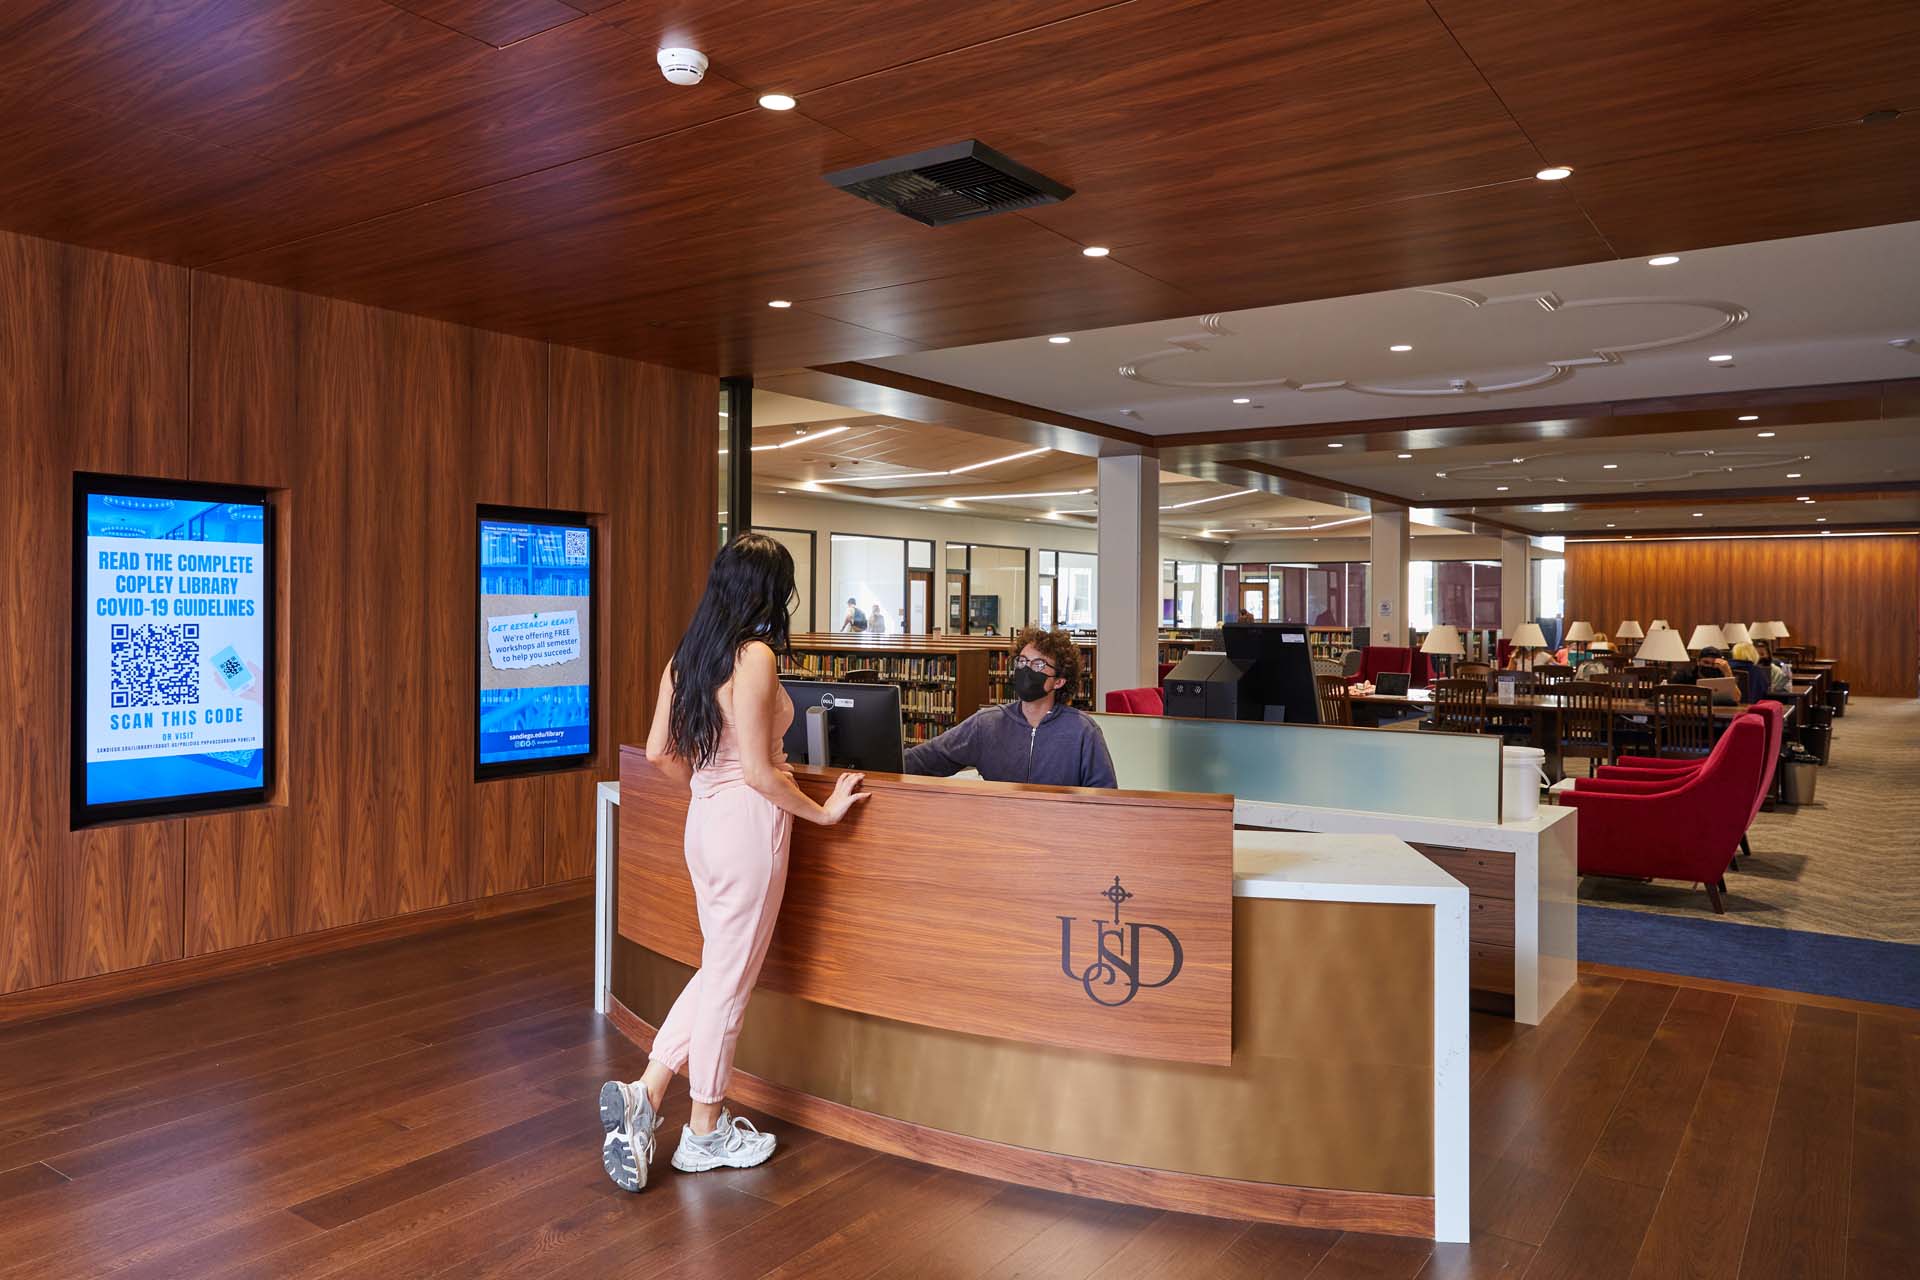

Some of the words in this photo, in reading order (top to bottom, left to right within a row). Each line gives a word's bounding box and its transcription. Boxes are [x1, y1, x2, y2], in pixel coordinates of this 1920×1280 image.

[99, 551, 139, 570] READ
[145, 553, 173, 571] THE
[178, 554, 253, 573] COMPLETE
[116, 575, 173, 593] COPLEY
[179, 576, 238, 594] LIBRARY
[97, 598, 168, 616] COVID-19
[174, 599, 254, 616] GUIDELINES
[491, 623, 508, 632] GET
[510, 621, 548, 630] RESEARCH
[503, 634, 524, 642] We're
[525, 631, 553, 640] offering
[496, 643, 535, 653] workshops
[547, 638, 578, 647] semester
[512, 653, 528, 662] help
[544, 647, 573, 657] succeed.
[110, 712, 153, 730] SCAN
[162, 710, 197, 727] THIS
[205, 707, 243, 724] CODE
[162, 733, 172, 741] OR
[175, 731, 194, 740] VISIT
[1056, 916, 1184, 1007] USD
